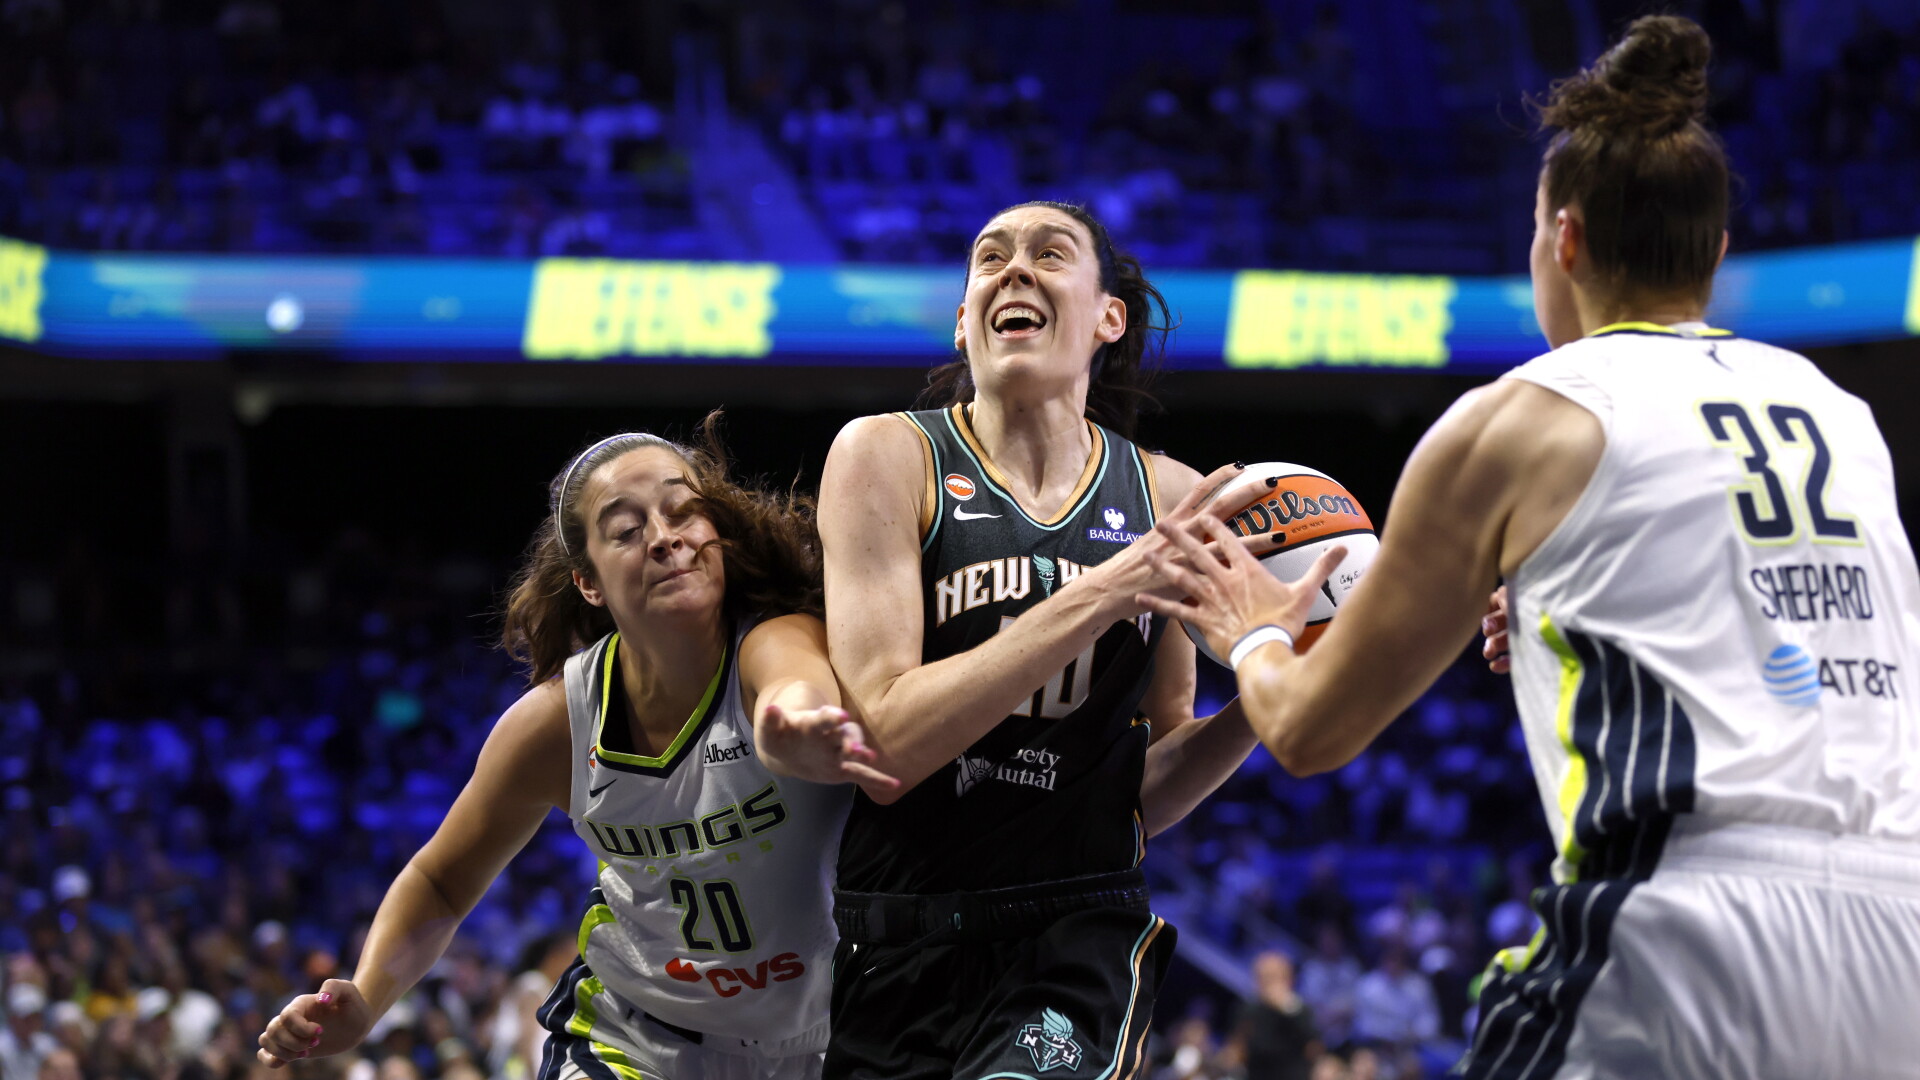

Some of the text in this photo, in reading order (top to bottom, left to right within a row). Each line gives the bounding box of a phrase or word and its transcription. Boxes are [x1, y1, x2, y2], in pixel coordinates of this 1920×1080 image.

[1694, 399, 1865, 547] 32
[1226, 491, 1360, 537] Wilson
[936, 556, 1030, 627] NEW
[1750, 564, 1873, 622] SHEPARD
[1819, 657, 1899, 700] AT&T
[704, 740, 751, 764] Albert
[585, 782, 788, 859] WINGS
[668, 876, 754, 954] 20
[705, 952, 805, 998] CVS
